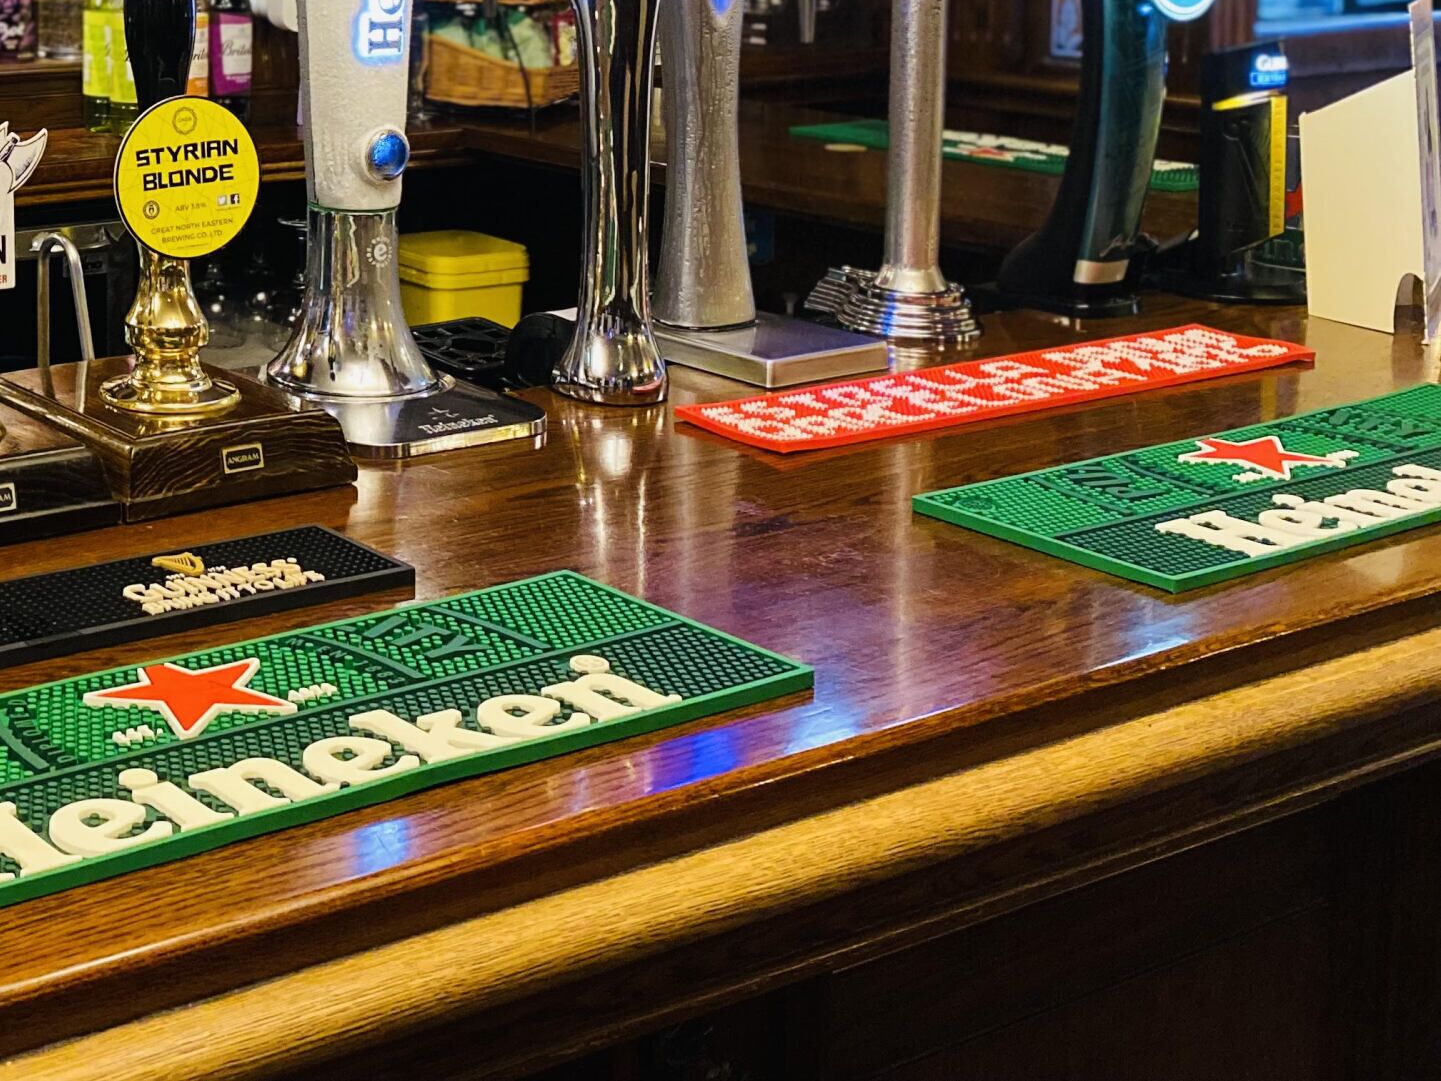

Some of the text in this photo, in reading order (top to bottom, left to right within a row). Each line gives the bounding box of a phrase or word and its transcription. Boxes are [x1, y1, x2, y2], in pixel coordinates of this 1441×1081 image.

[135, 138, 239, 168] STYRIAN
[142, 163, 235, 192] BLONDE
[150, 218, 234, 236] GREAT NORTH EASTERN
[161, 233, 197, 245] BREWING
[418, 413, 500, 435] Heineken
[227, 453, 260, 465] ANGRAM
[122, 560, 302, 603] GUINNESS
